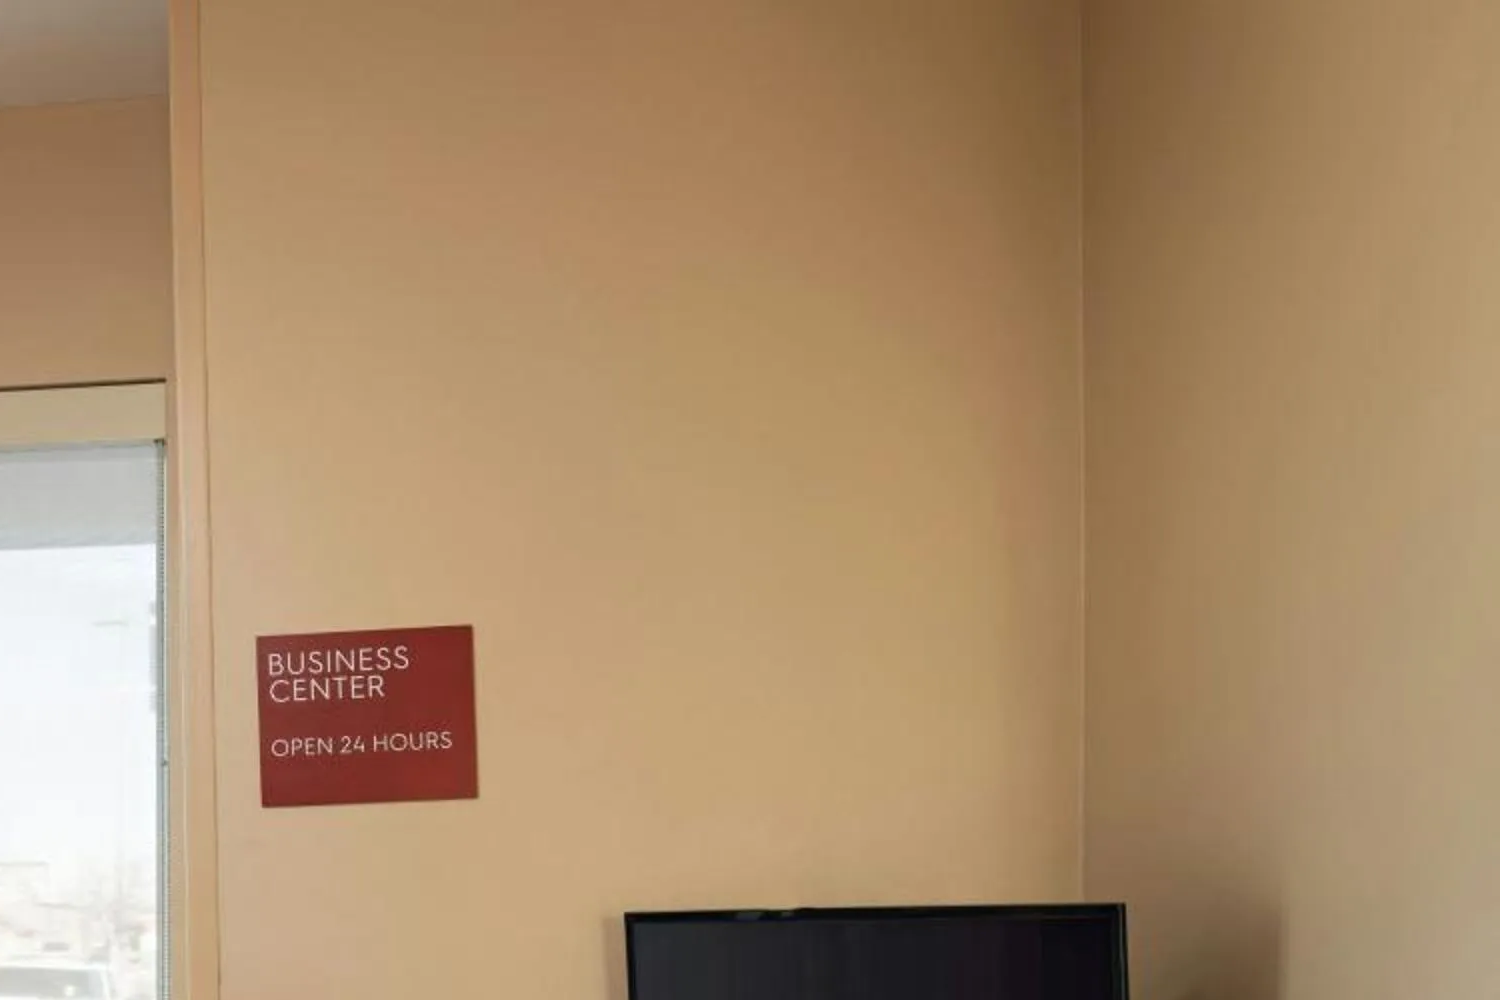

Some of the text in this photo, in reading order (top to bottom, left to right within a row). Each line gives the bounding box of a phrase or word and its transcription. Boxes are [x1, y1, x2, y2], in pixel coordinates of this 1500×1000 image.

[268, 645, 410, 675] BUSINESS
[269, 675, 385, 703] CENTER
[271, 730, 453, 757] OPEN 24 HOURS
